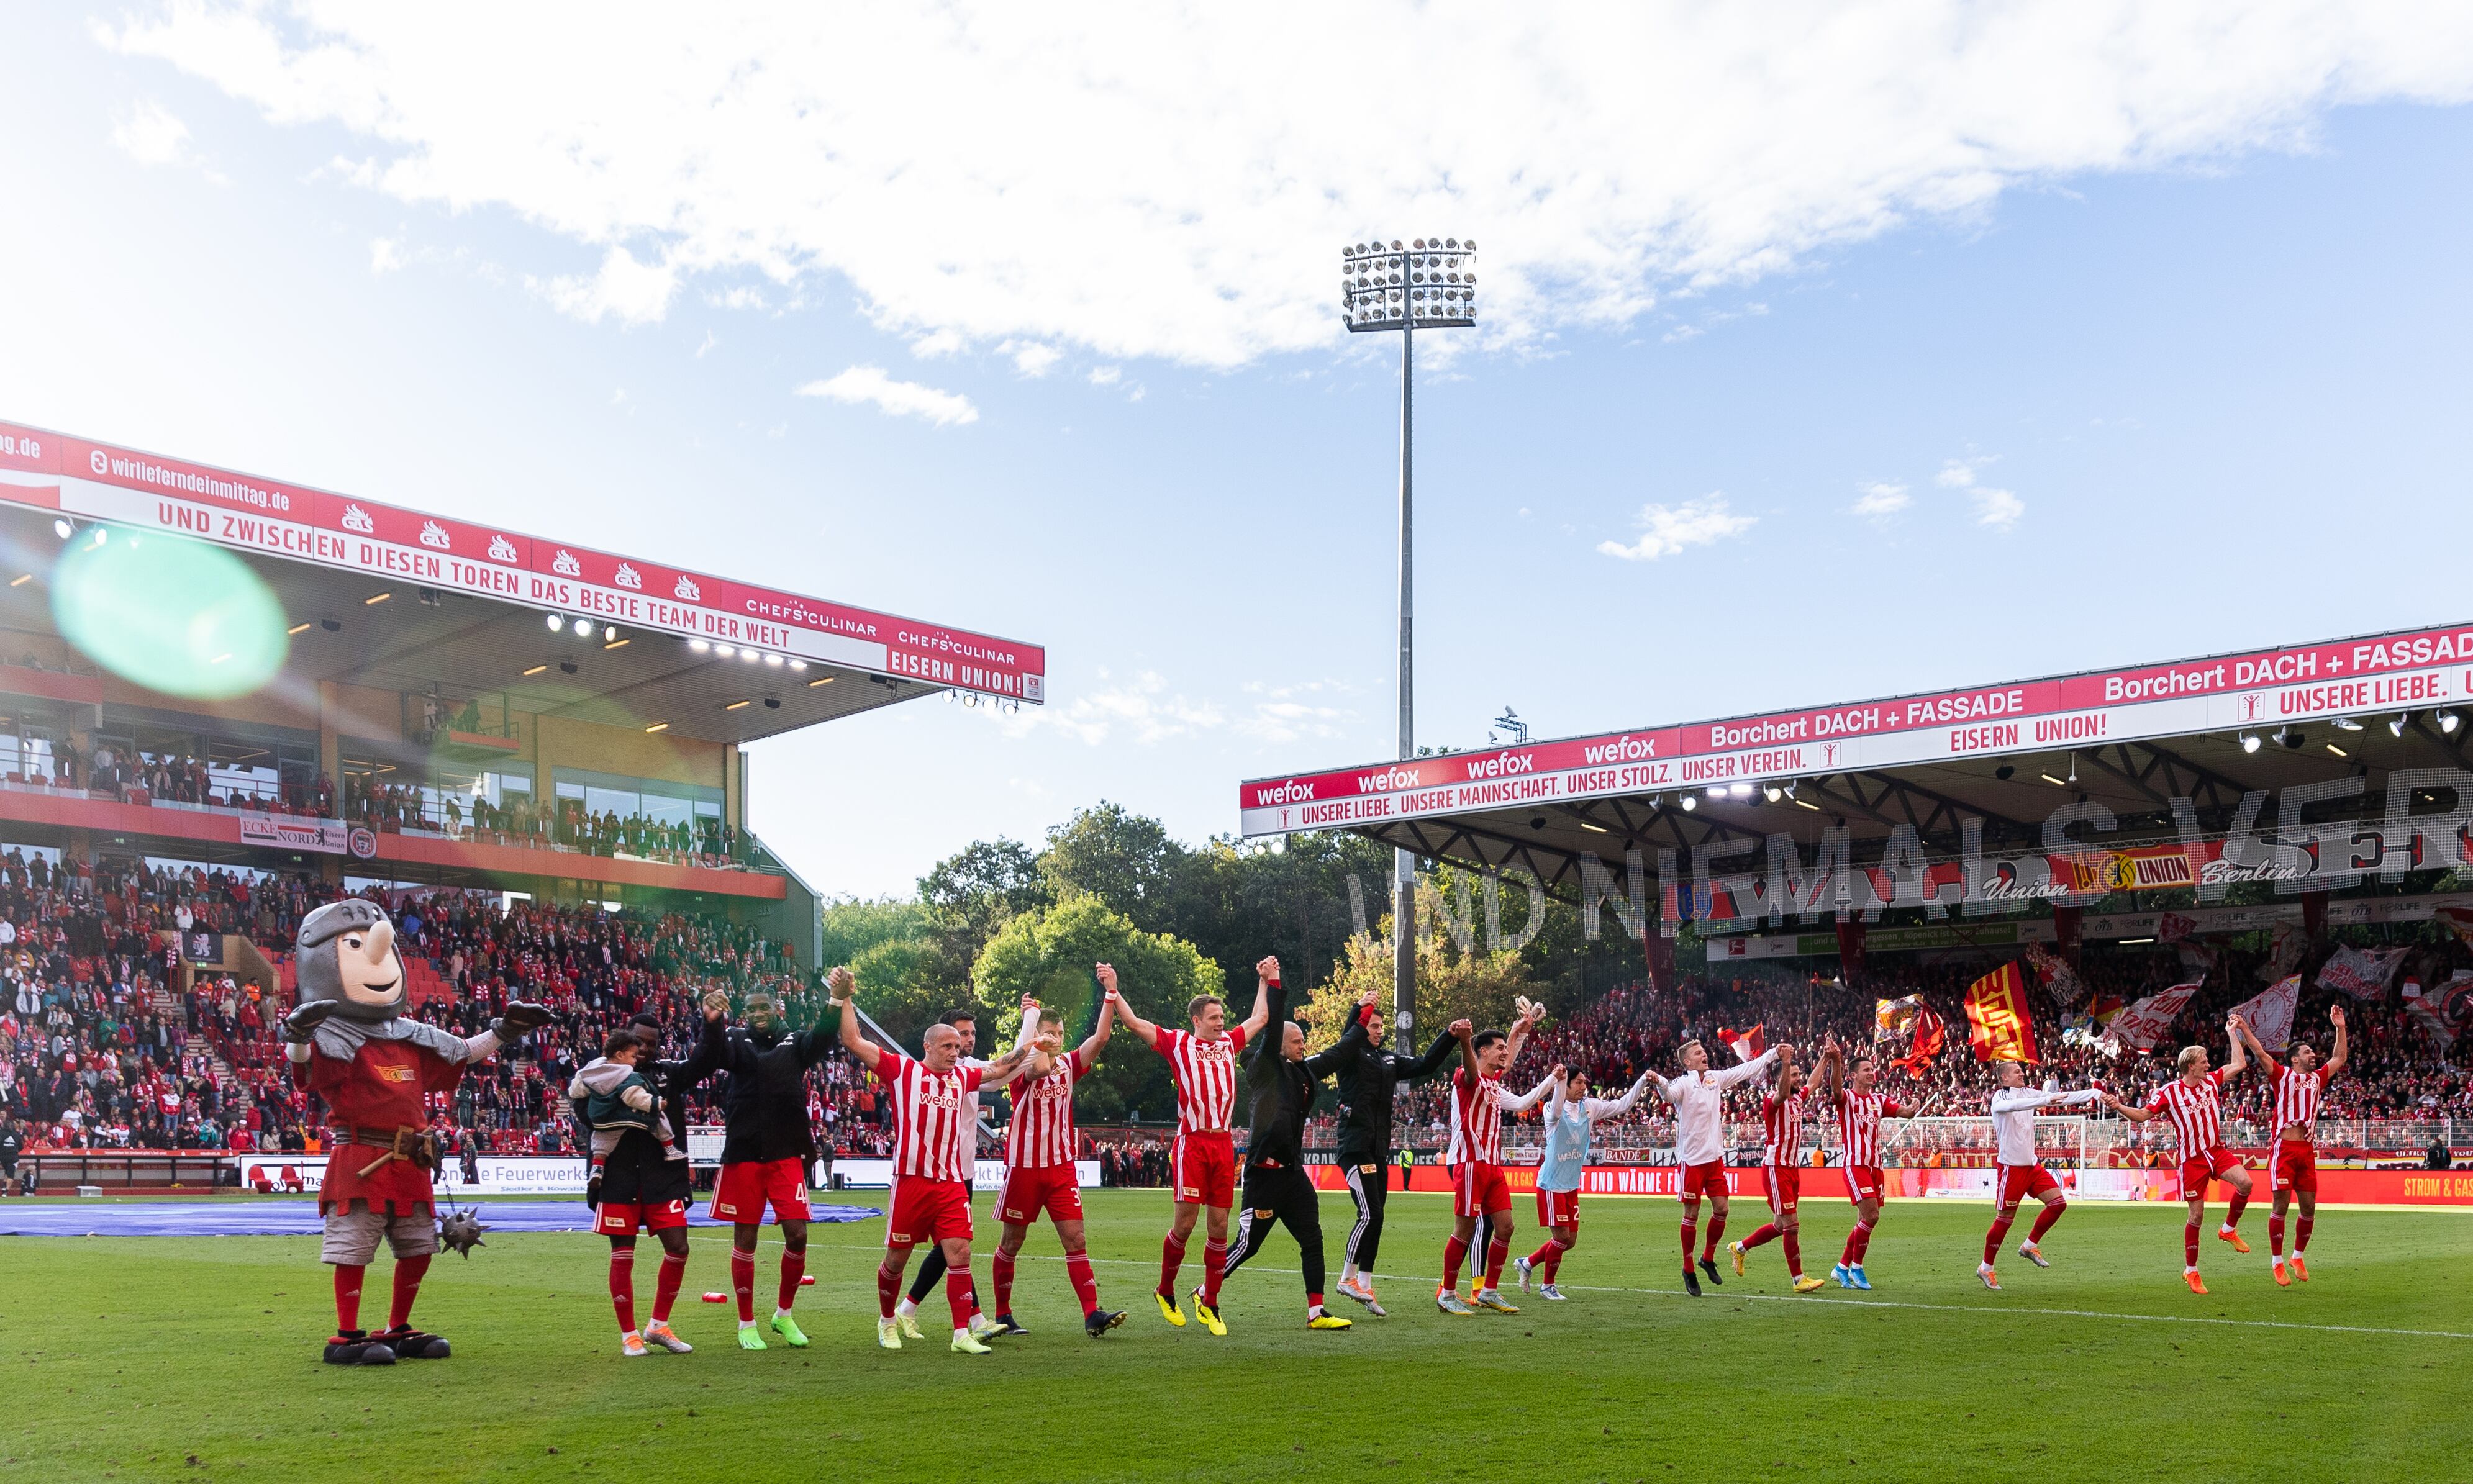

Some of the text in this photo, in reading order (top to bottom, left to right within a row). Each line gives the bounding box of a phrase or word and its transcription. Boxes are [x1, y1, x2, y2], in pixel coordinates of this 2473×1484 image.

[112, 457, 289, 511] wirlieferndeinmittag.de
[158, 502, 791, 648] UND ZWISCHEN DIESEN TOREN DAS BESTE TEAM DER WELT
[891, 651, 1022, 694] EISERN UNION!
[2105, 663, 2225, 701] Borchert
[2236, 653, 2316, 684] DACH
[2326, 656, 2343, 672] +
[2280, 682, 2368, 715] UNSERE
[2375, 674, 2448, 704] LIEBE.
[1711, 690, 2023, 748] Borchert DACH + FASSADE
[1951, 713, 2107, 751] EISERN UNION!
[1257, 735, 1655, 805] wefox wefox wefox wefox
[1302, 749, 1807, 824] UNSERE LIEBE. UNSERE MANNSCHAFT. UNSER STOLZ. UNSER VEREIN.
[243, 821, 315, 844] ECKE NORD
[325, 830, 345, 838] Eisern
[325, 840, 345, 848] Union
[1982, 856, 2299, 900] Union UNION Berlin
[919, 1091, 960, 1110] wefox
[1033, 1084, 1068, 1100] wefox
[2293, 1079, 2316, 1091] wefo
[1520, 1172, 1533, 1187] GAS
[1590, 1172, 1613, 1192] UND
[1618, 1169, 1661, 1192] WÄRME
[2404, 1177, 2440, 1197] STROM
[2443, 1177, 2452, 1197] &
